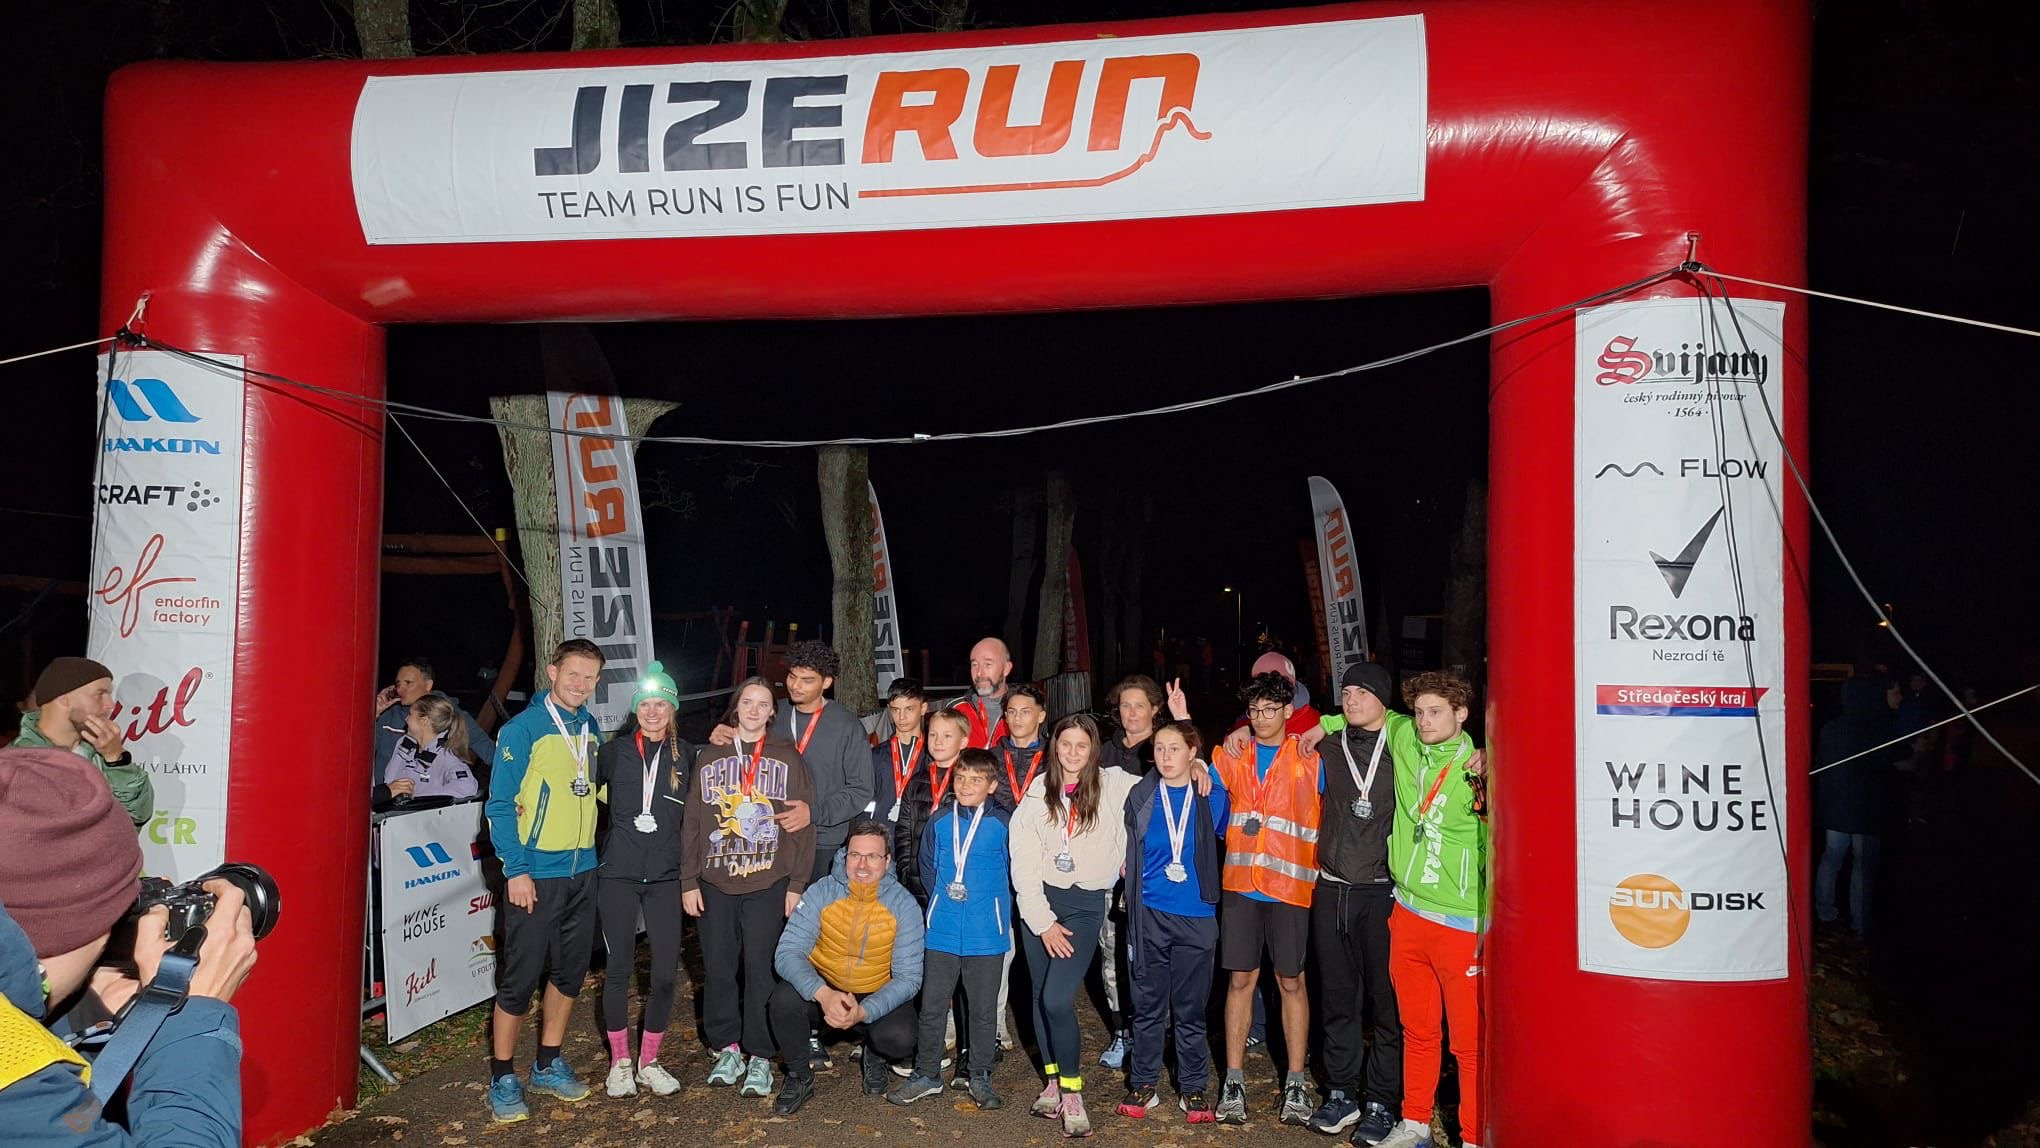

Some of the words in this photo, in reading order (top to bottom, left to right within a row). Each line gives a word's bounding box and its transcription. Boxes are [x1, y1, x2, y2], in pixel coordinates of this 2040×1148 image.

[538, 190, 636, 219] TEAM
[651, 186, 723, 216] RUN
[736, 185, 766, 213] IS
[777, 182, 850, 211] FUN
[1595, 335, 1768, 385] Svijany
[1624, 390, 1653, 405] český
[1655, 390, 1703, 404] rodinný
[1705, 391, 1746, 404] pivovar
[1680, 459, 1768, 479] FLOW
[99, 484, 185, 506] CRAFT
[155, 597, 220, 609] endorfin
[153, 610, 210, 625] factory
[1609, 606, 1755, 641] Rexona
[1653, 649, 1708, 662] Nezradí
[1713, 650, 1725, 662] tě
[1618, 689, 1717, 707] Středočeský
[1720, 691, 1746, 706] kraj
[164, 762, 207, 774] LÁHVI
[1605, 761, 1742, 794] WINE
[1612, 798, 1767, 832] HOUSE
[148, 810, 197, 845] ČR
[405, 869, 461, 889] HAAKON
[1609, 888, 1766, 911] SUNDISK
[403, 903, 440, 925] WINE
[403, 915, 446, 942] HOUSE
[405, 957, 437, 1007] Kitl
